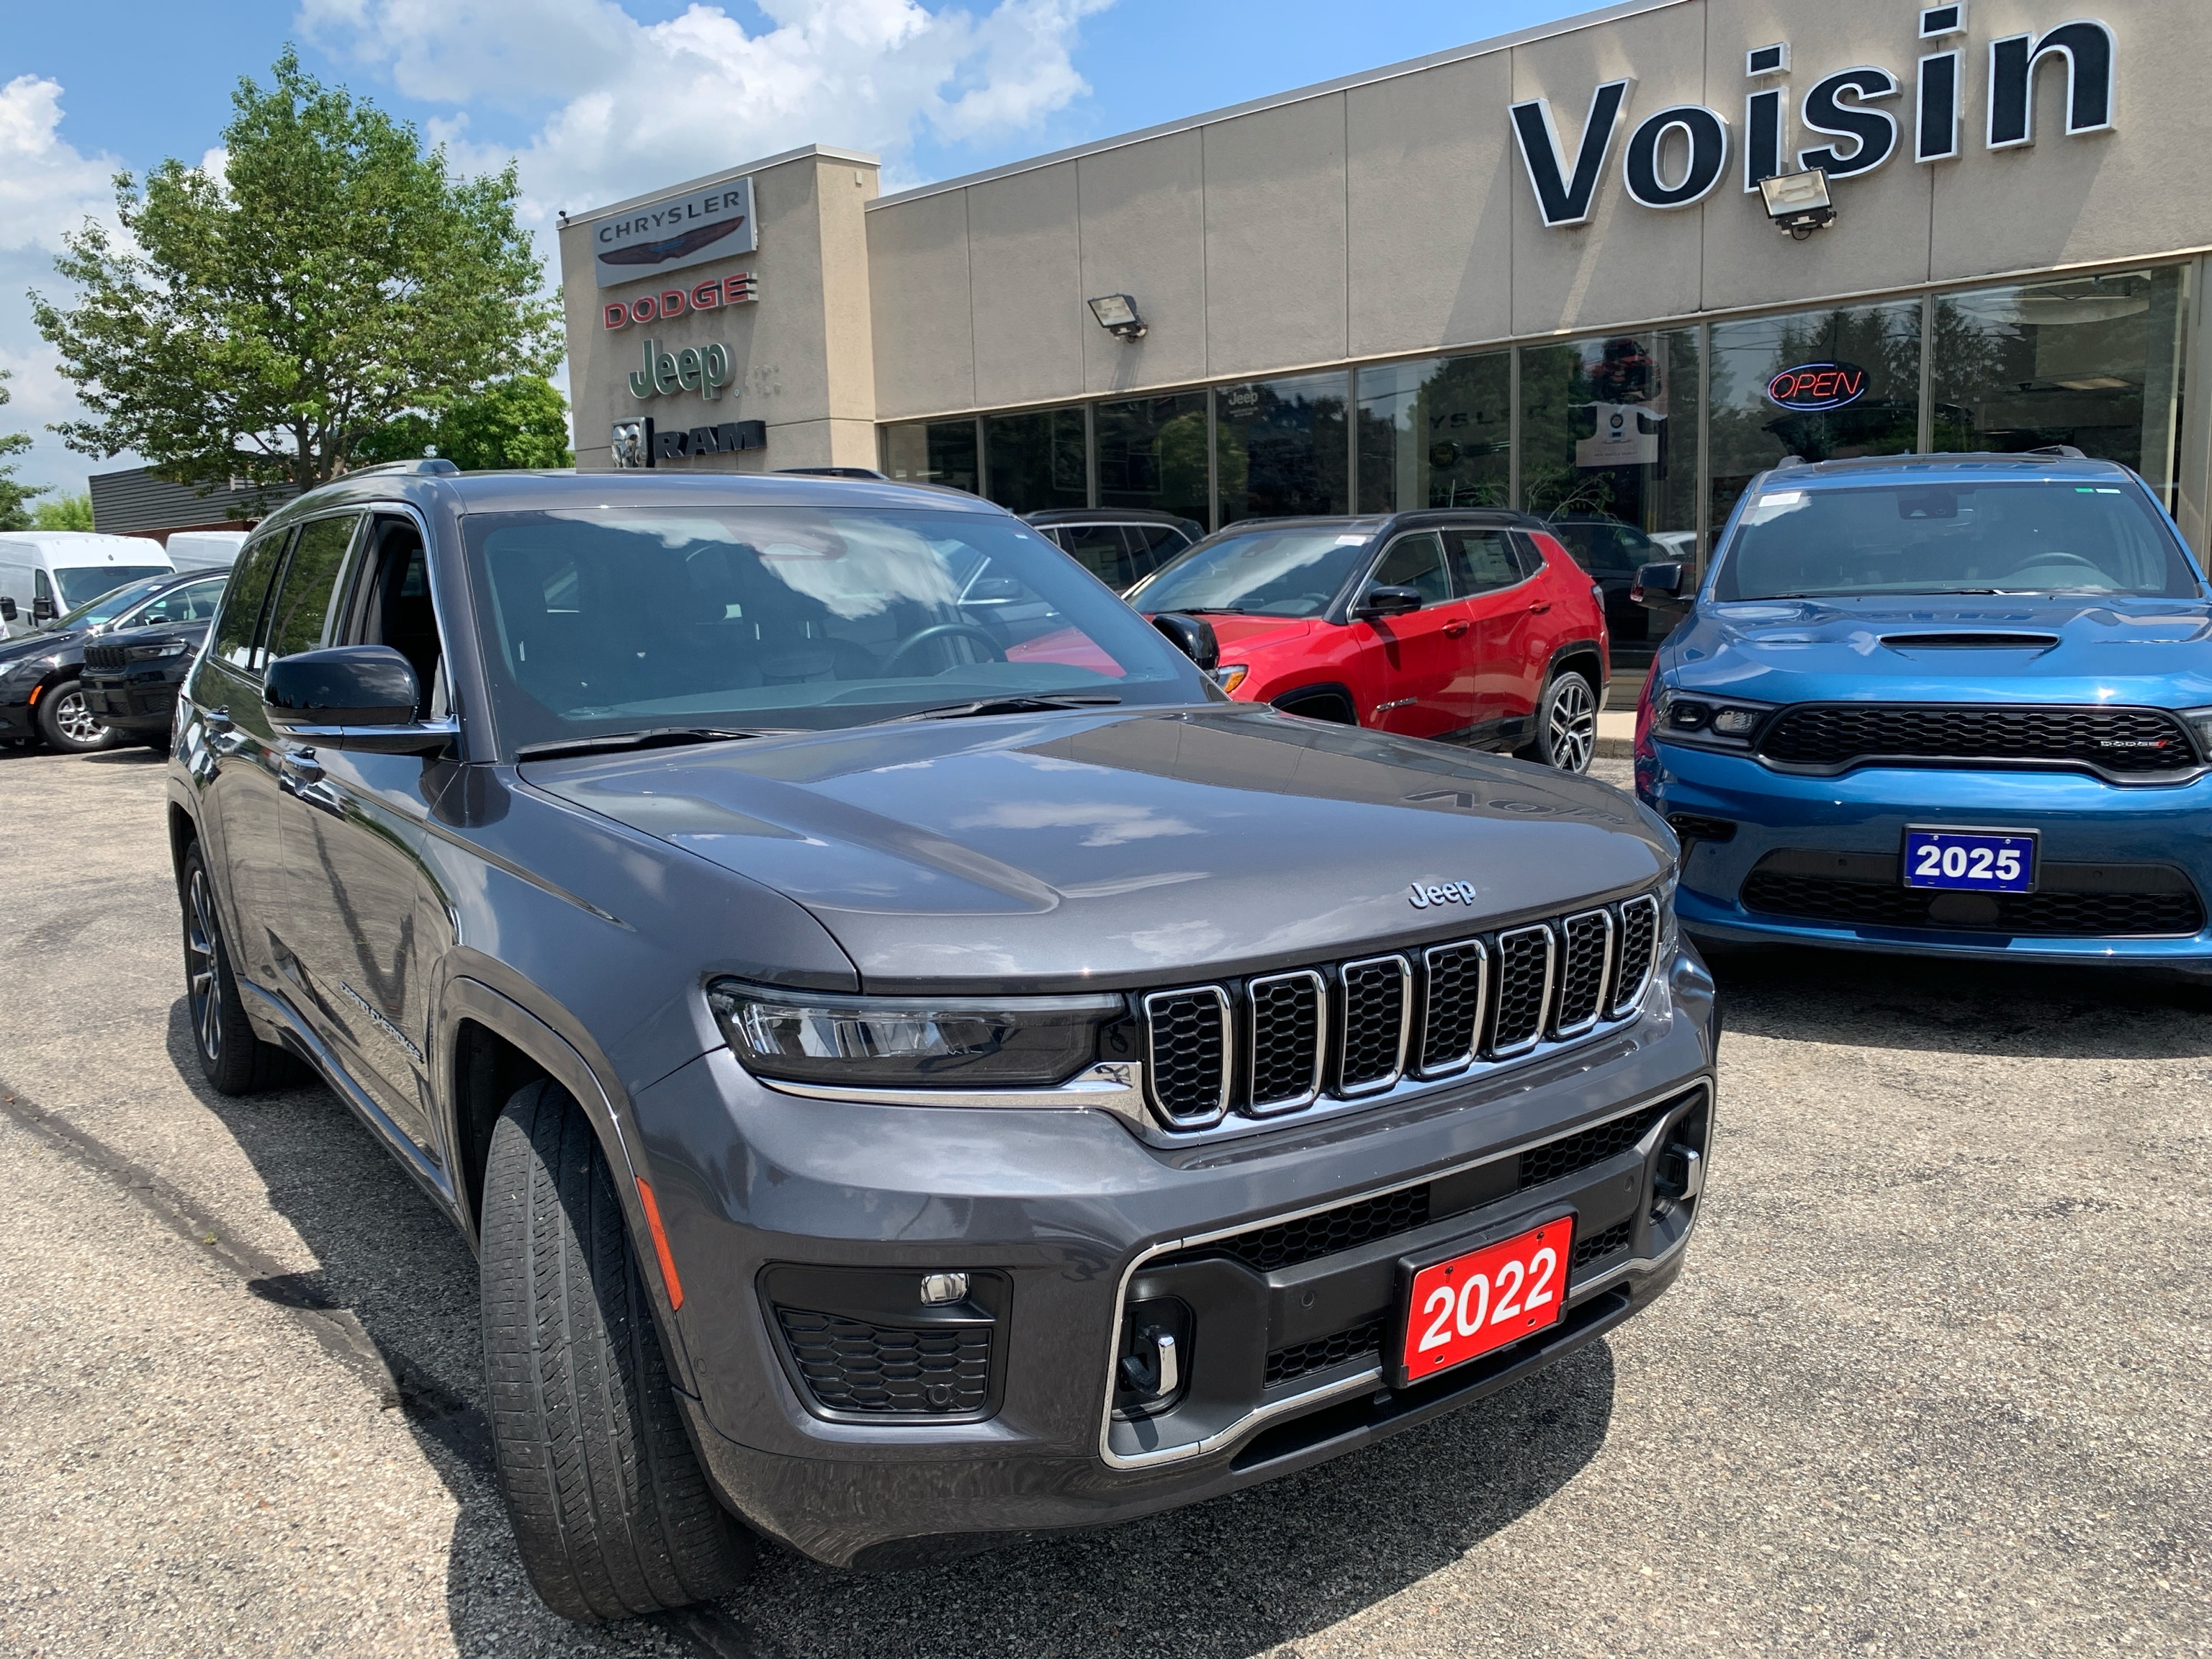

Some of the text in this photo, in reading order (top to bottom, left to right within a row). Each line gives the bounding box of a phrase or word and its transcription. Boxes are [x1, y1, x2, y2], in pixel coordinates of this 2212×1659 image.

[1506, 1, 2118, 228] Voisin
[599, 191, 739, 243] CHRYSLER
[603, 271, 755, 331] DODGE
[629, 338, 729, 400] Jeep
[1772, 371, 1862, 398] OPEN
[1228, 391, 1259, 406] Jeep
[654, 420, 765, 461] RAM
[1915, 845, 2021, 881] 2025
[1409, 881, 1476, 909] Jeep
[1418, 1247, 1557, 1353] 2022
